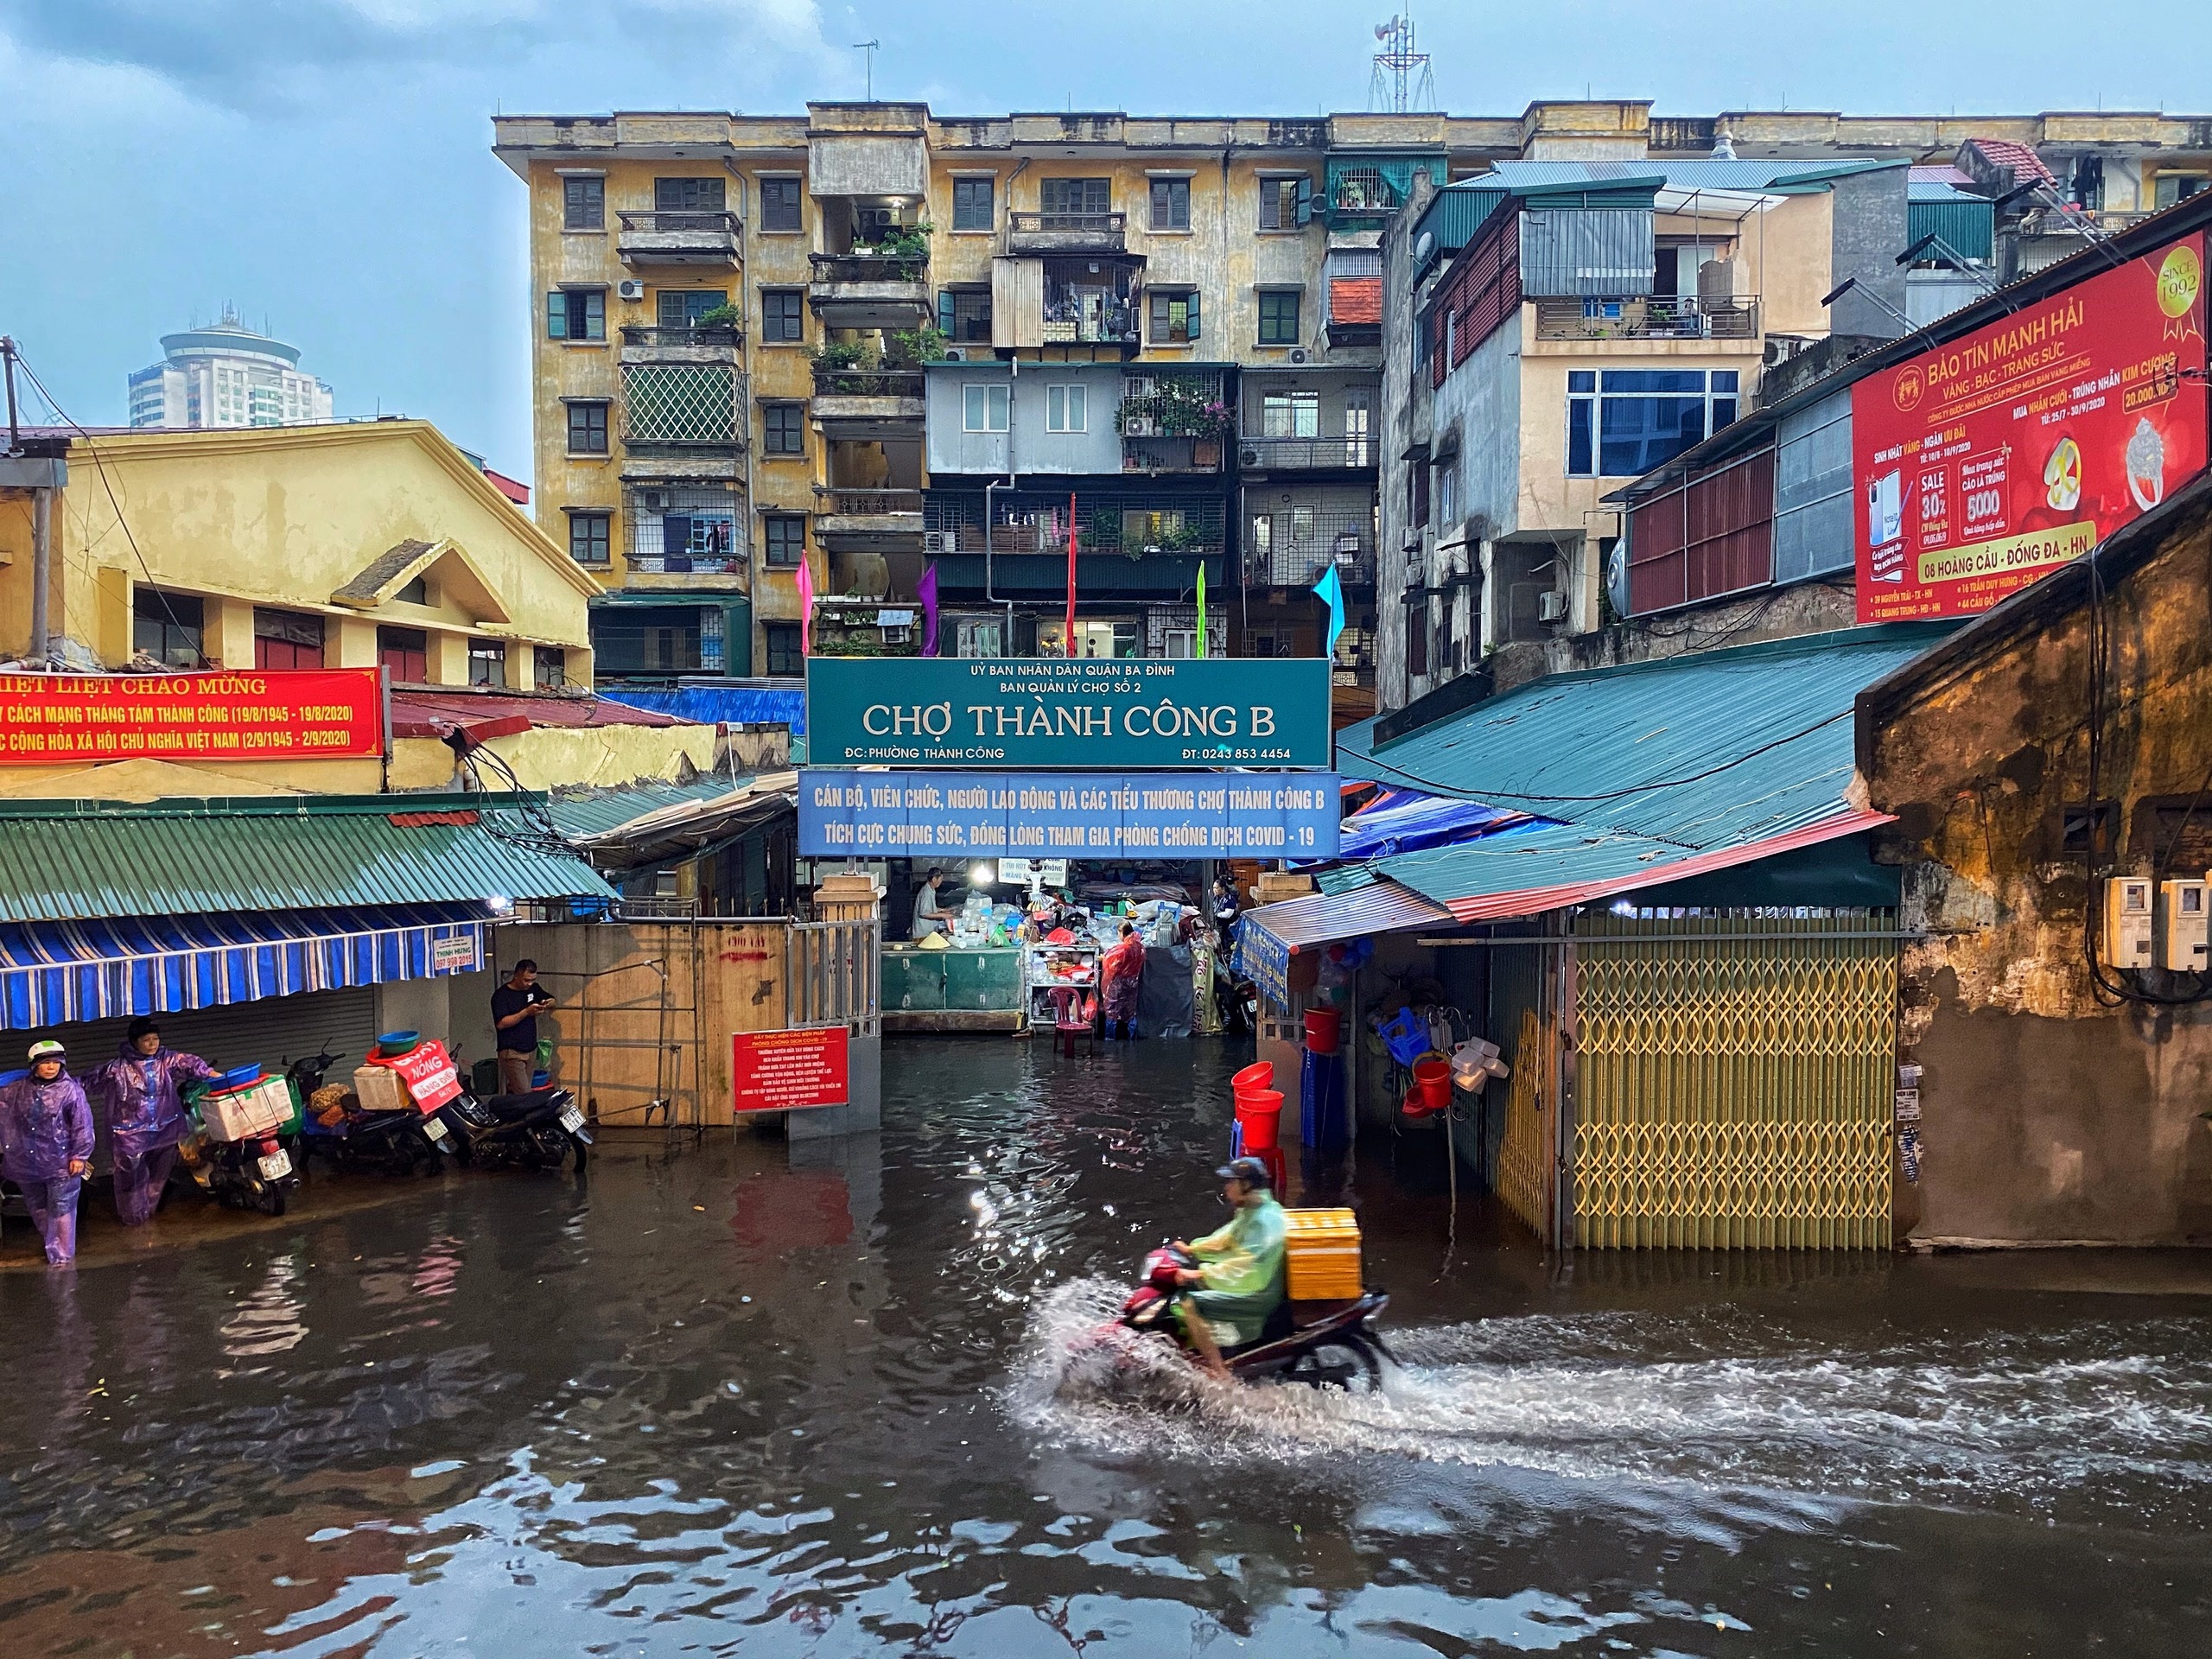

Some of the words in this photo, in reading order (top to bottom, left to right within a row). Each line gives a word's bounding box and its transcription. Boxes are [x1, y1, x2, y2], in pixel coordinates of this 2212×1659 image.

[2163, 260, 2194, 283] SINCE
[2163, 275, 2196, 302] 1992
[1928, 353, 1960, 386] BẢO
[1962, 340, 1989, 372] TÍN
[1993, 316, 2046, 360] MẠNH
[2050, 296, 2083, 337] HẢI
[1942, 380, 1970, 400] VÀNG
[1975, 369, 1997, 390] BẠC
[2002, 352, 2039, 378] TRANG
[2041, 340, 2065, 363] SỨC
[2012, 404, 2028, 420] MUA
[2072, 380, 2096, 399] TRÚNG
[2122, 365, 2139, 383] KIM
[2051, 409, 2066, 423] 25/7
[2070, 397, 2106, 416] 30/9/2020
[1873, 450, 1887, 464] SINH
[1921, 471, 1944, 493] SALE
[1922, 492, 1946, 520] 30%
[1967, 488, 2000, 523] 5000
[1924, 563, 1936, 579] 08
[1937, 555, 1974, 576] HOÀNG
[1976, 545, 1998, 569] CẦU
[2006, 539, 2040, 565] ĐỐNG
[2044, 540, 2061, 559] ĐA
[2070, 535, 2088, 554] HN
[970, 661, 985, 676] UỶ
[989, 665, 1014, 676] BAN
[1017, 663, 1052, 676] NHÂN
[1056, 663, 1081, 676] DÂN
[1085, 663, 1120, 678] QUẬN
[1125, 665, 1141, 676] BA
[1145, 662, 1175, 676] ĐÌNH
[0, 676, 48, 697] IỆT
[55, 677, 114, 698] LIỆT
[121, 676, 190, 695] CHÀO
[197, 674, 267, 695] MỪNG
[1000, 683, 1026, 693] BAN
[1027, 679, 1064, 693] QUẢN
[1067, 679, 1080, 693] LÝ
[1081, 682, 1109, 696] CHỢ
[1114, 677, 1130, 693] SỐ
[1134, 682, 1141, 693] 2
[7, 702, 41, 723] CÁCH
[45, 706, 83, 727] MẠNG
[86, 702, 125, 723] THÁNG
[128, 702, 154, 723] TÁM
[156, 703, 194, 723] THÀNH
[197, 702, 229, 723] CÔNG
[232, 706, 289, 724] (19/8/1945
[299, 705, 353, 722] 19/8/2020)
[863, 701, 952, 742] CHỢ
[967, 695, 1113, 736] THÀNH
[1123, 697, 1237, 737] CÔNG
[1249, 706, 1276, 737] B
[10, 729, 45, 754] CỘNG
[48, 729, 73, 751] HÒA
[77, 730, 94, 750] XÃ
[97, 729, 118, 753] HỘI
[120, 726, 144, 750] CHỦ
[147, 729, 184, 749] NGHĨA
[186, 729, 210, 752] VIỆT
[213, 732, 239, 748] NAM
[242, 731, 293, 750] (2/9/1945
[302, 730, 351, 747] 2/9/2020)
[844, 747, 868, 758] ĐC:
[868, 745, 919, 759] PHƯỜNG
[924, 746, 963, 759] THÀNH
[965, 746, 1005, 759] CÔNG
[1182, 749, 1200, 759] ĐT:
[1202, 748, 1231, 760] 0243
[1235, 748, 1257, 760] 853
[1260, 748, 1291, 759] 4454
[814, 783, 842, 808] CÁN
[845, 784, 868, 811] BỘ,
[870, 785, 901, 808] VIÊN
[905, 784, 944, 811] CHỨC,
[947, 785, 988, 810] NGƯỜI
[991, 790, 1016, 810] LAO
[1020, 786, 1056, 814] ĐỘNG
[1059, 786, 1077, 810] VÀ
[1080, 786, 1107, 810] CÁC
[1110, 783, 1139, 810] TIỂU
[1142, 788, 1194, 810] THƯƠNG
[1198, 788, 1226, 814] CHỢ
[1229, 785, 1272, 810] THÀNH
[1274, 785, 1312, 810] CÔNG
[1315, 790, 1325, 810] B
[824, 820, 854, 843] TÍCH
[857, 823, 884, 848] CỰC
[887, 824, 933, 845] CHUNG
[936, 819, 967, 848] SỨC,
[969, 819, 1007, 846] ĐỒNG
[1009, 821, 1044, 846] LÒNG
[1047, 826, 1085, 846] THAM
[1089, 826, 1111, 846] GIA
[1114, 822, 1160, 846] PHÒNG
[1162, 819, 1208, 846] CHỐNG
[1211, 826, 1243, 850] DỊCH
[1246, 826, 1286, 846] COVID
[1298, 826, 1315, 846] 19
